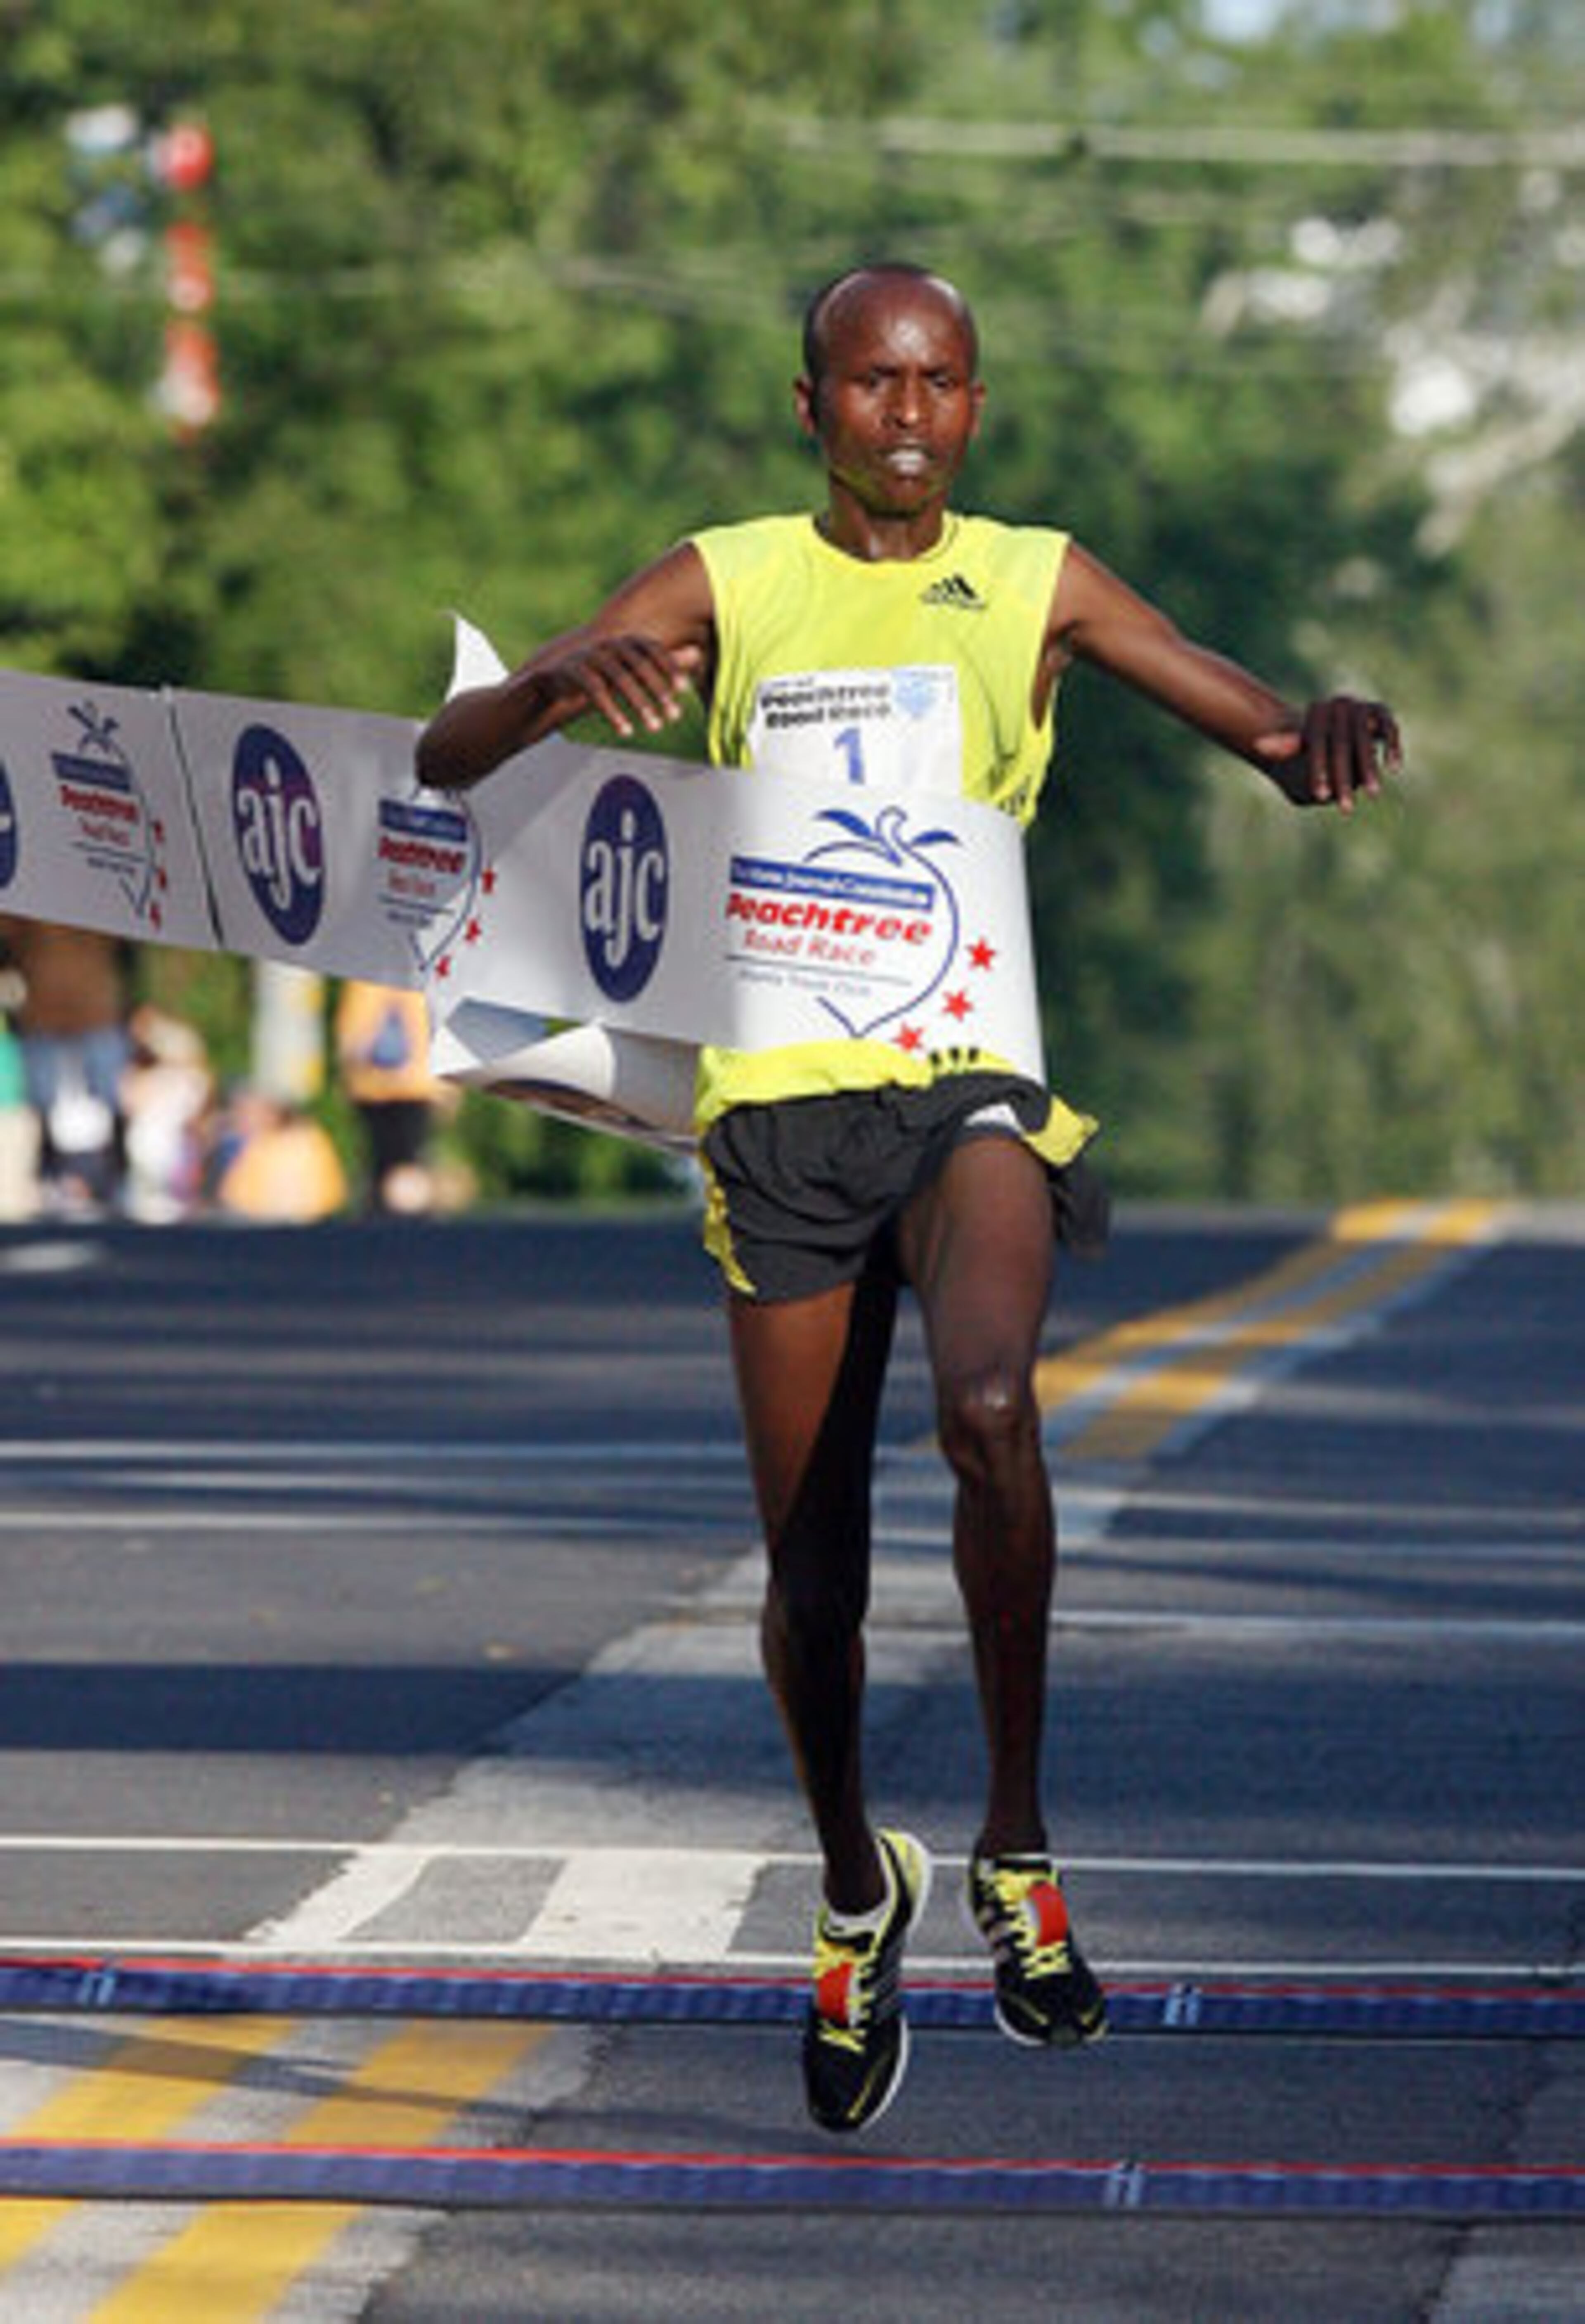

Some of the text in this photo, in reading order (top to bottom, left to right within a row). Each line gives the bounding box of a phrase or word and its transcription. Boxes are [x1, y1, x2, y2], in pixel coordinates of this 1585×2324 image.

[833, 726, 866, 785] 1
[237, 757, 323, 910] ajc
[584, 810, 664, 968] ajc
